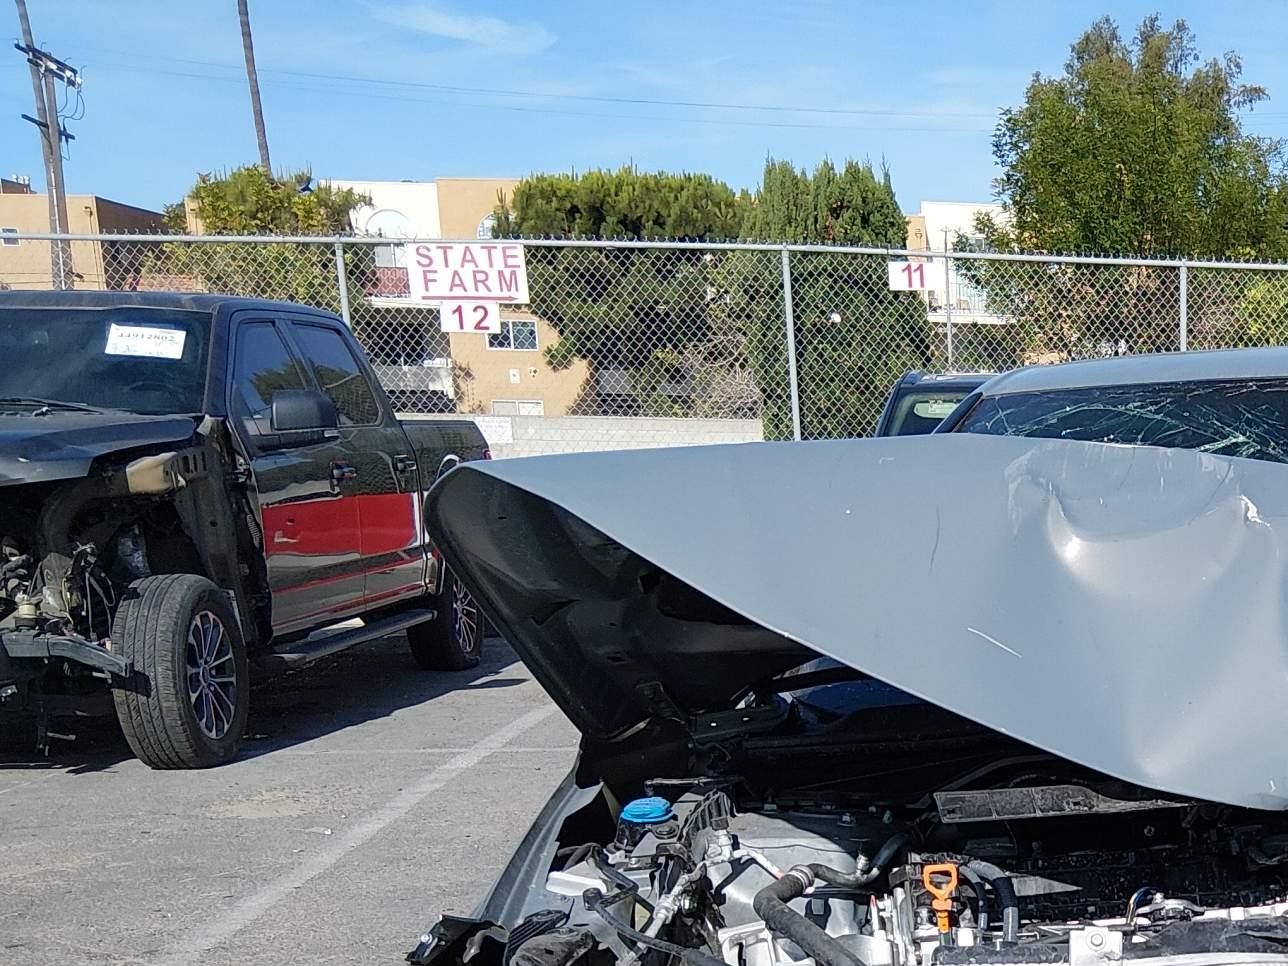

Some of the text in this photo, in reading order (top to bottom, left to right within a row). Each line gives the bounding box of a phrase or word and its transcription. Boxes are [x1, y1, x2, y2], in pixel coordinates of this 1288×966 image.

[415, 244, 521, 269] STATE
[421, 269, 519, 293] FARM
[901, 263, 925, 289] 11
[451, 304, 490, 331] 12
